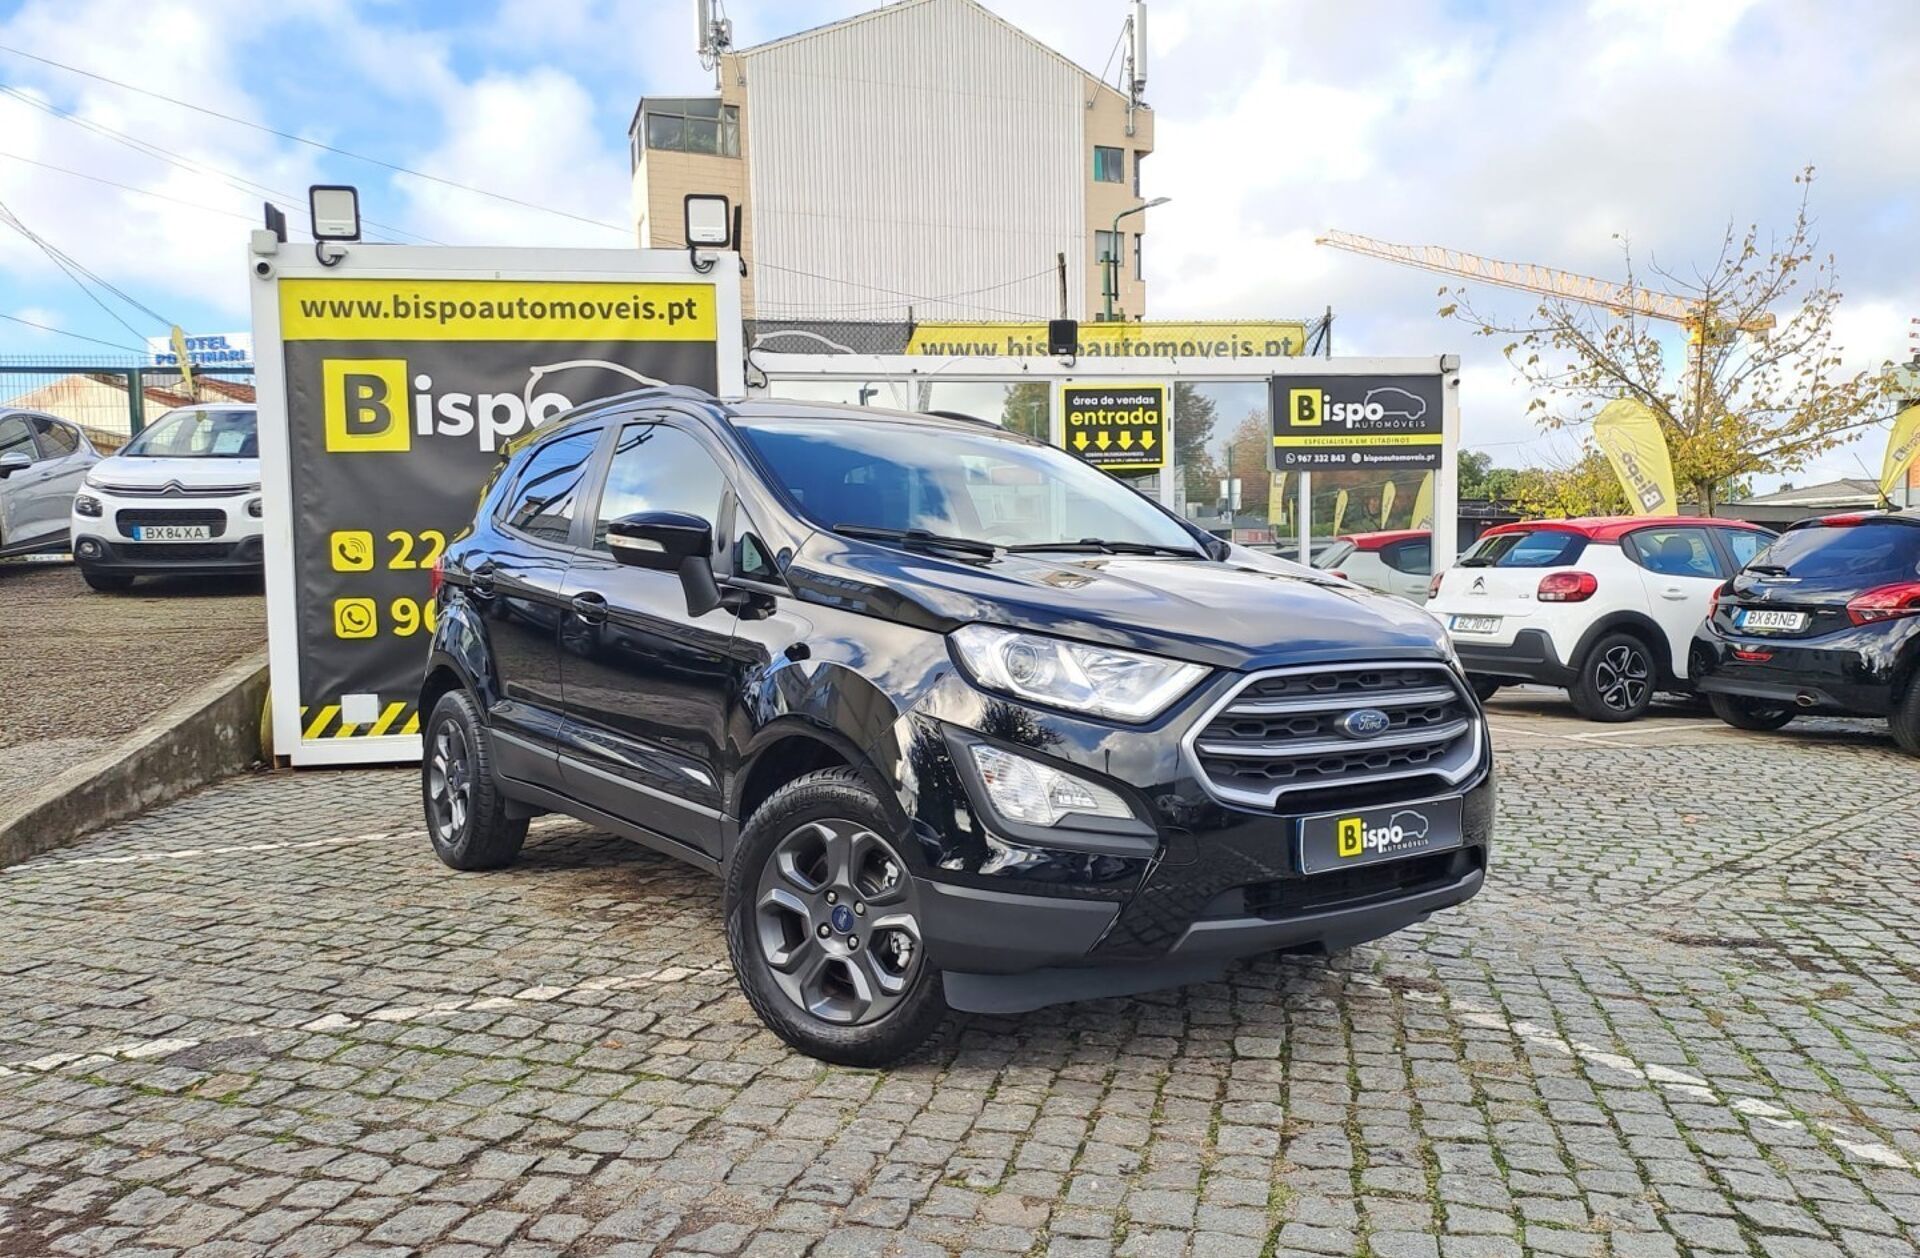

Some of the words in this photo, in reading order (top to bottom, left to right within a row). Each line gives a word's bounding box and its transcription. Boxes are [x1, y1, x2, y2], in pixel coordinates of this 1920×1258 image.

[301, 294, 698, 325] www.bispoautomoveis.pt
[921, 334, 1292, 357] wwwbisautomoveis.pt
[155, 350, 245, 364] POTINARI
[1073, 396, 1098, 405] área
[1100, 396, 1114, 405] de
[1116, 395, 1155, 405] vendas
[344, 374, 573, 451] Bispo
[1070, 407, 1158, 425] entrada
[1297, 395, 1384, 428] Bispo
[1355, 419, 1426, 428] AUTOMÓVEIS
[1297, 454, 1311, 462] 967
[1314, 454, 1329, 462] 332
[1331, 454, 1346, 462] 843
[1363, 453, 1435, 463] bispoautomoveis.pt
[1359, 715, 1382, 730] Ford
[1344, 822, 1403, 853] Bispo
